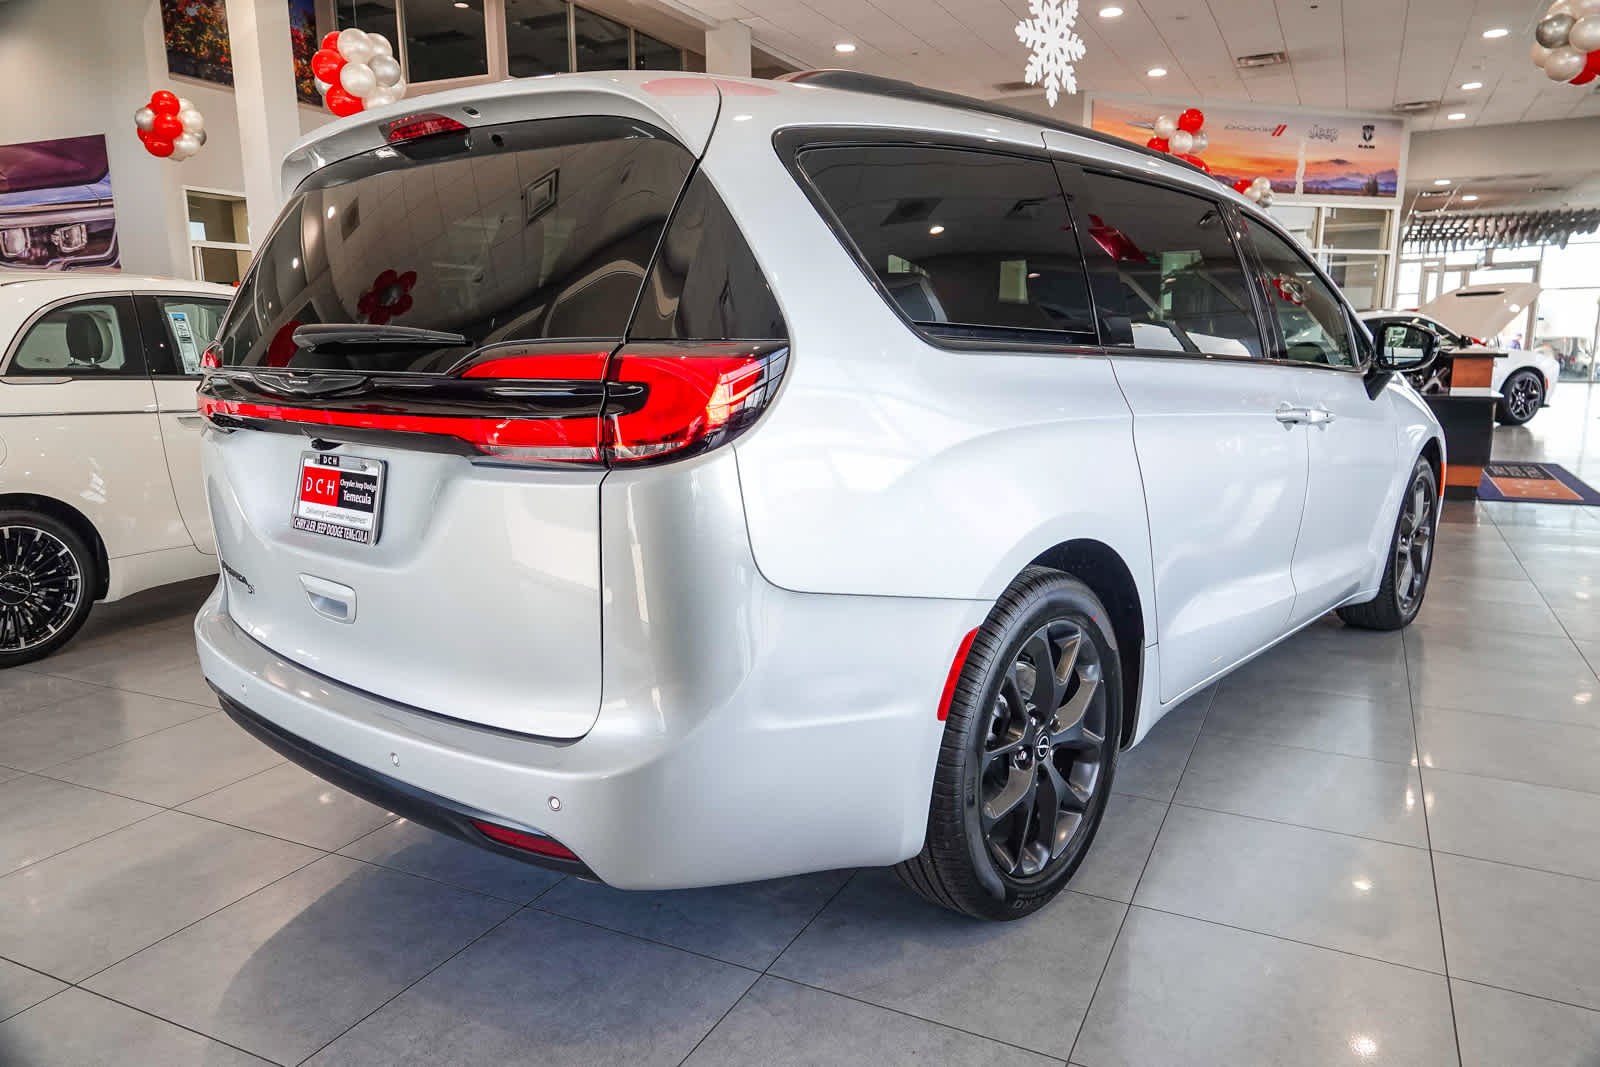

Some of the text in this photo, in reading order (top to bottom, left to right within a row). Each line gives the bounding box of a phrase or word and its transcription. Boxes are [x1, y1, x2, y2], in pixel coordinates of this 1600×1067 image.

[363, 482, 376, 492] Dodge
[343, 490, 371, 504] Temecula
[316, 522, 326, 533] JEEP
[326, 525, 343, 537] DODGE
